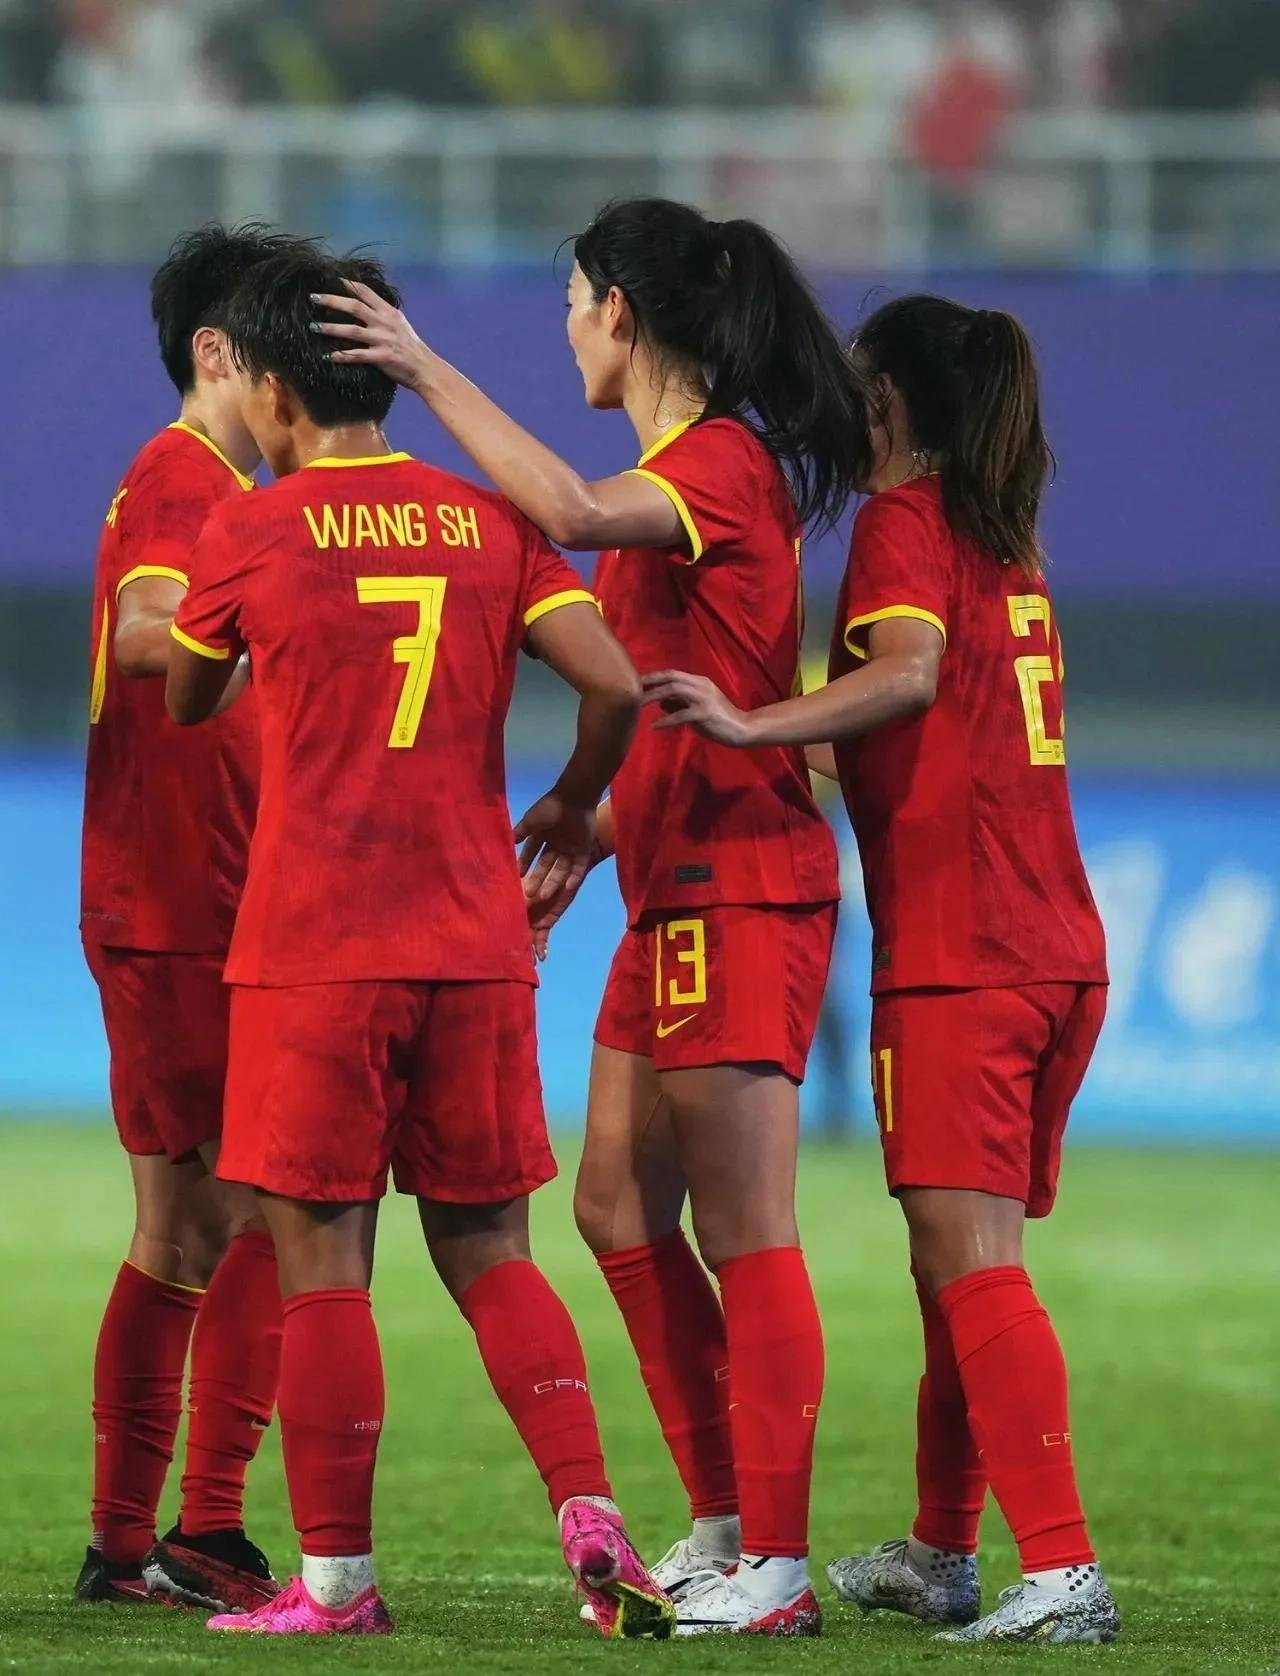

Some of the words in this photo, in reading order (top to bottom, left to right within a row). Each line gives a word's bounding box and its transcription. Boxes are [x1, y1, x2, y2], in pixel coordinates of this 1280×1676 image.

[303, 502, 427, 549] WANG
[436, 503, 481, 549] SH
[356, 575, 448, 748] 7
[1006, 594, 1066, 765] 2
[655, 919, 707, 1007] 13
[533, 1379, 587, 1394] CFA
